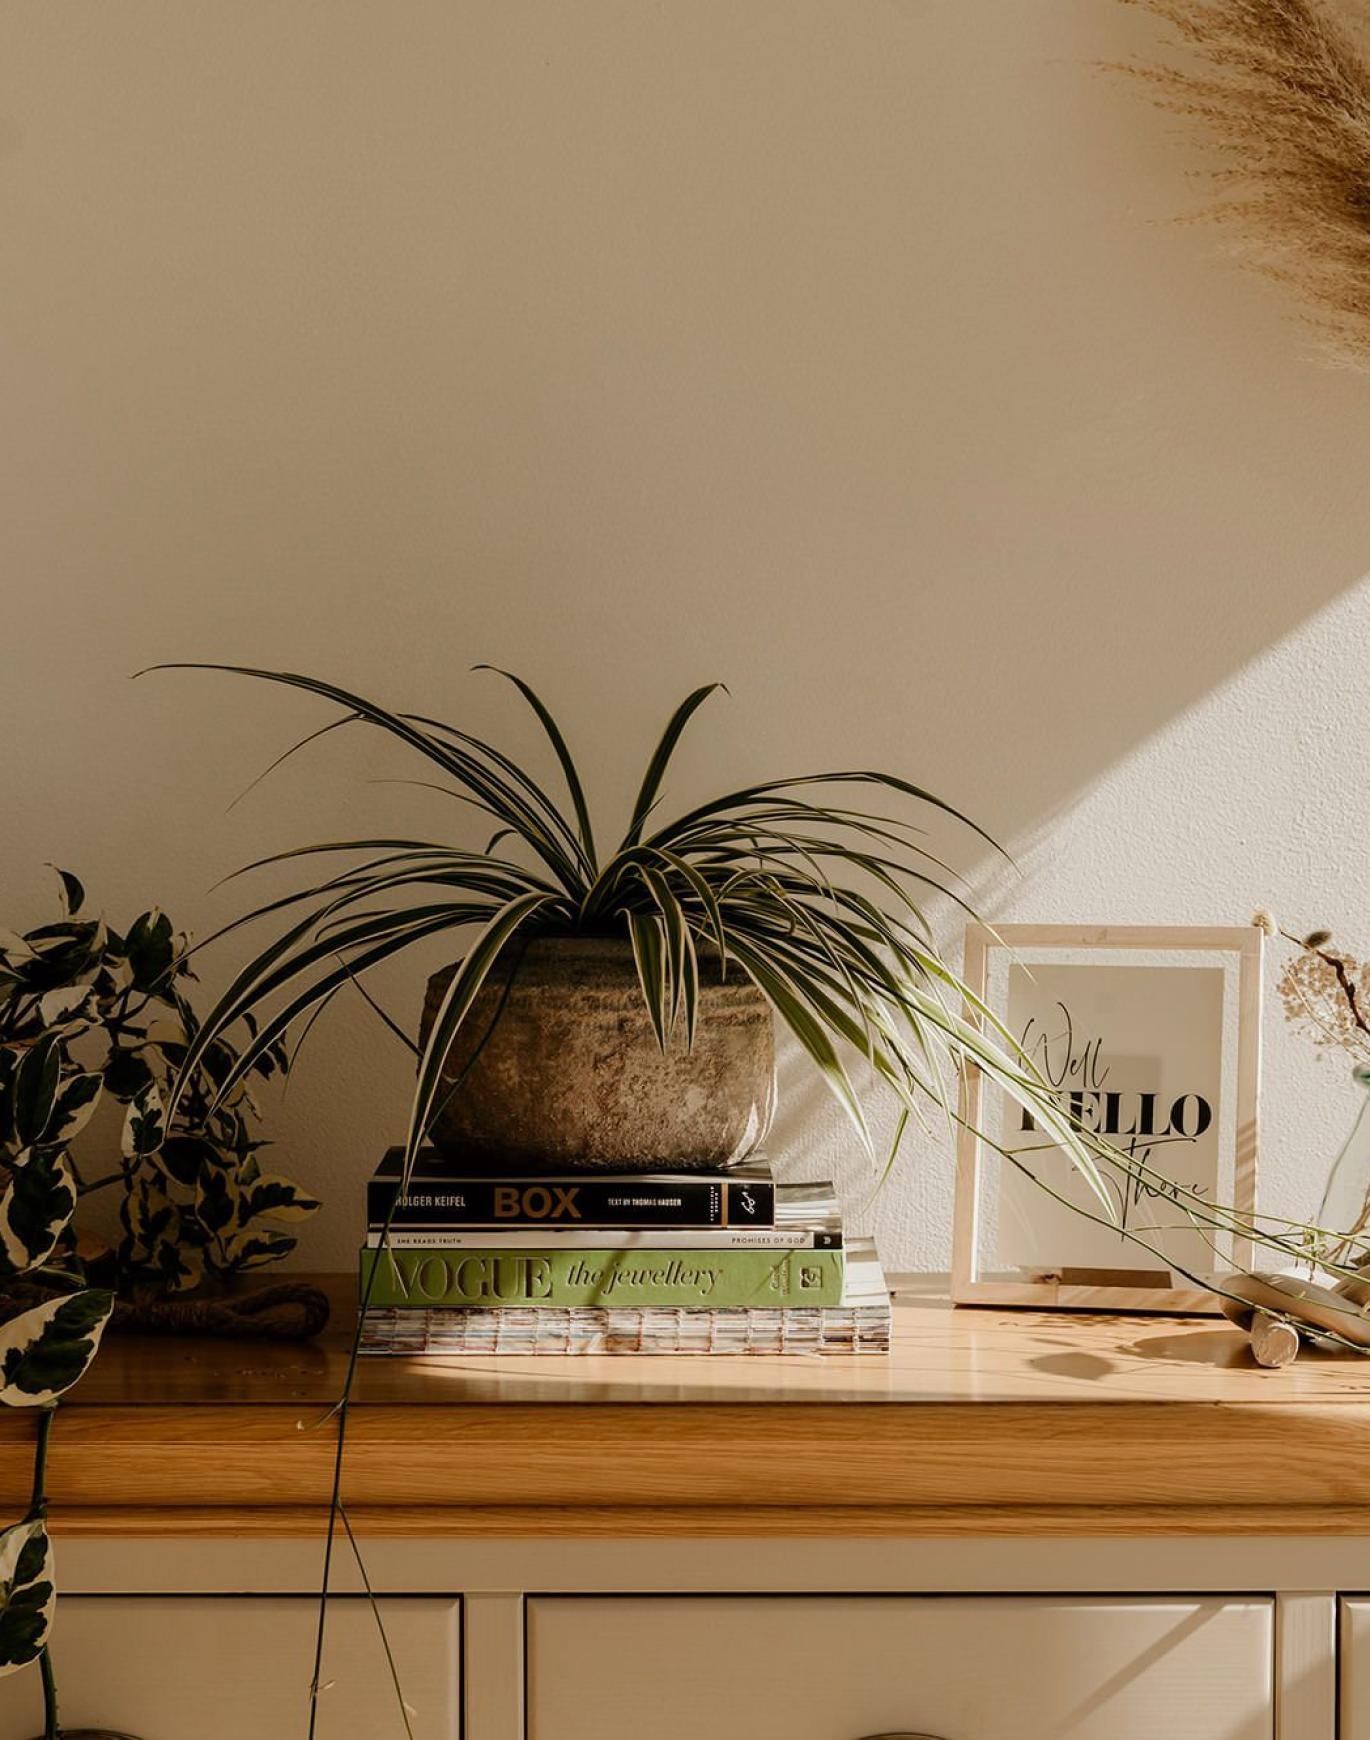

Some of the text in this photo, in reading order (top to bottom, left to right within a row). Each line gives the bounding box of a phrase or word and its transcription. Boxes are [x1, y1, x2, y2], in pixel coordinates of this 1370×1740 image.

[1018, 1001, 1110, 1088] Well
[434, 1196, 466, 1207] KEIFEL
[494, 1187, 582, 1218] BOX
[393, 1256, 552, 1299] VOGUE
[567, 1260, 723, 1295] the jewellery
